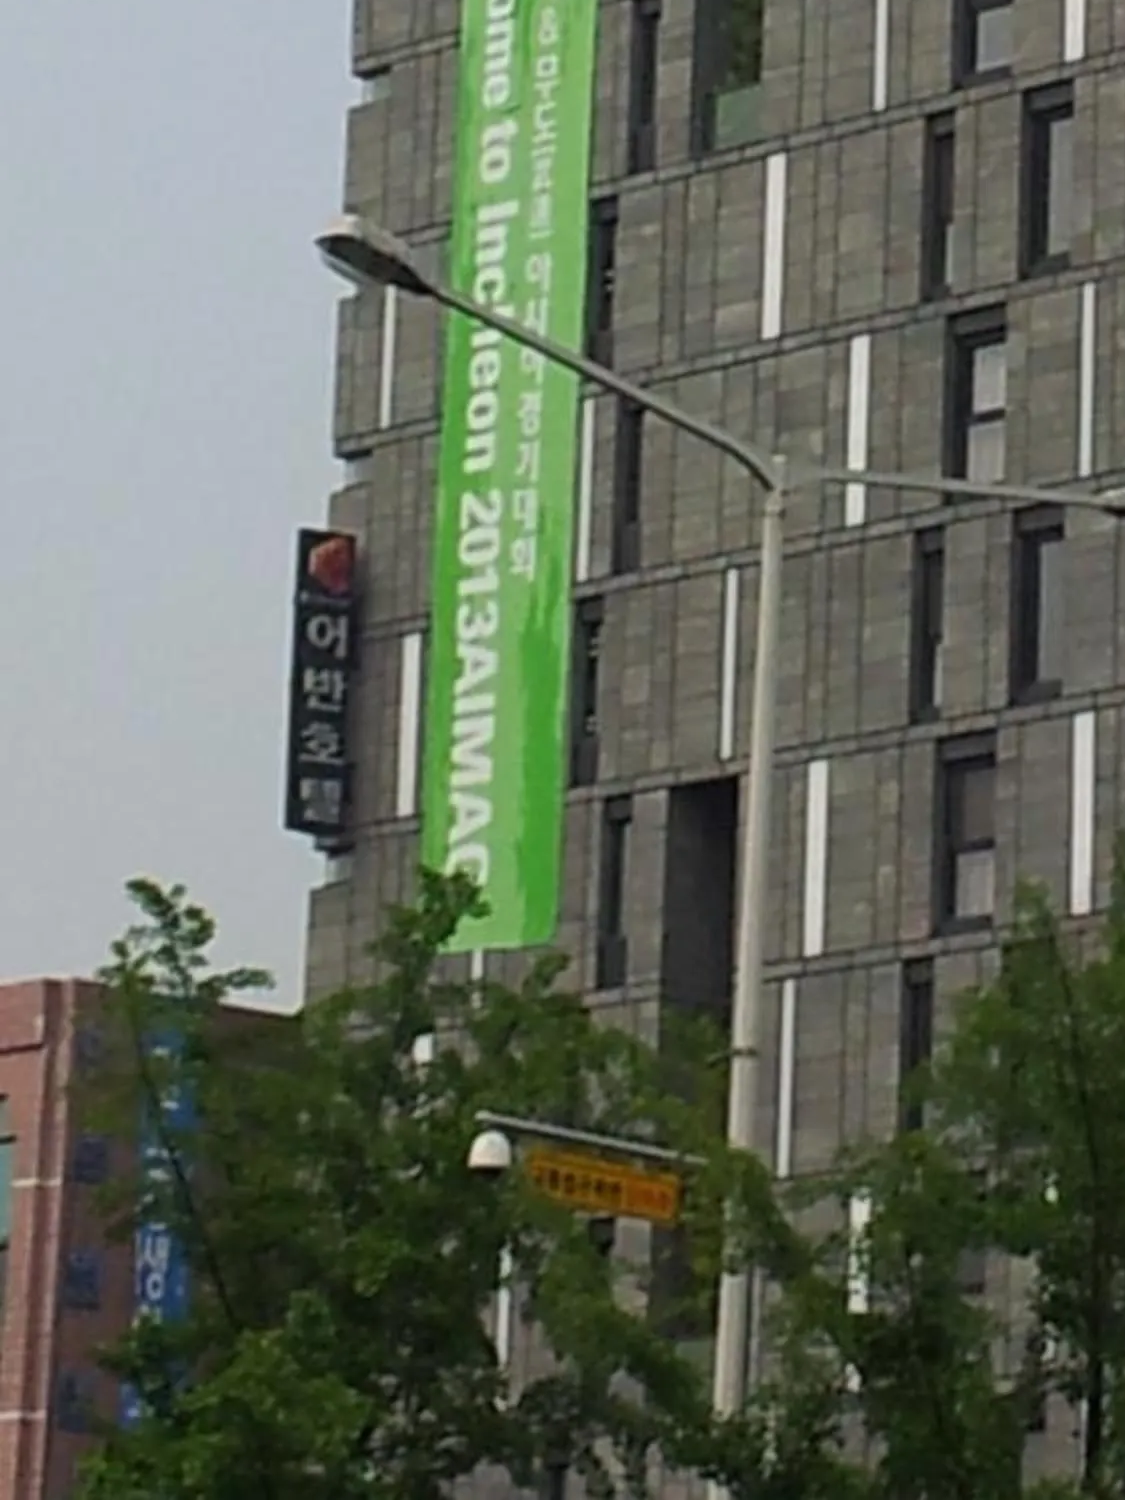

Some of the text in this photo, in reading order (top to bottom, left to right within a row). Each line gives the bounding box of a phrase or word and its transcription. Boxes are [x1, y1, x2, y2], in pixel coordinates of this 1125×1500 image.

[477, 118, 518, 183] to
[461, 199, 520, 475] Incheon
[298, 614, 349, 824] 어반호텔
